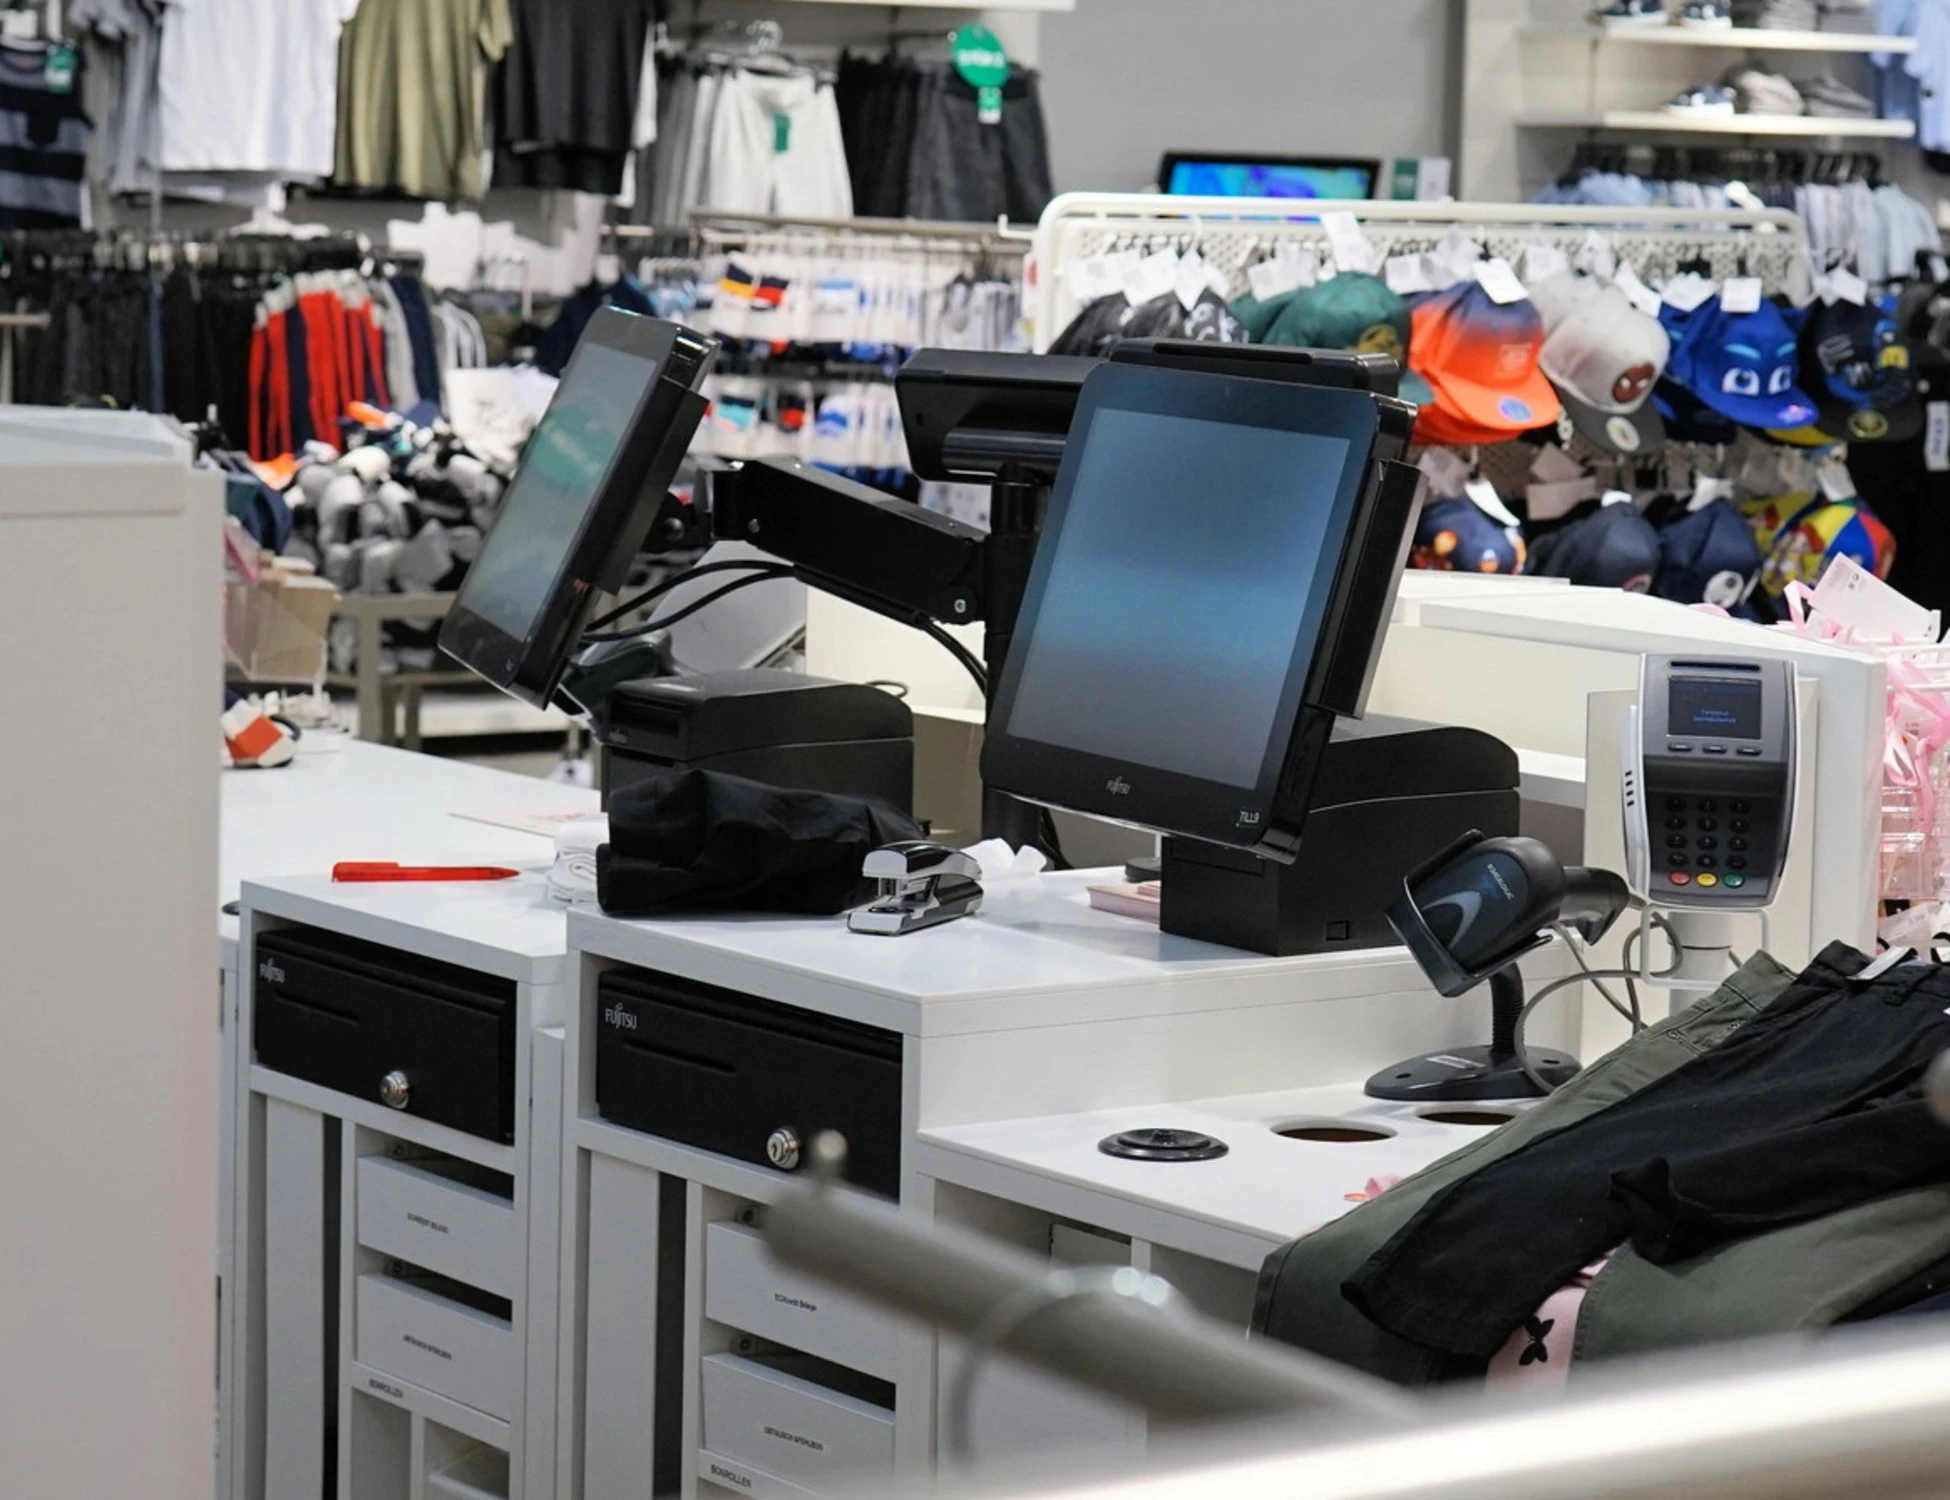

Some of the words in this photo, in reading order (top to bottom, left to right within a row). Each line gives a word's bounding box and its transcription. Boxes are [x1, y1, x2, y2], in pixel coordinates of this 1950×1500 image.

[1106, 775, 1131, 796] FUJITSU
[605, 1002, 637, 1030] FUJITSU
[710, 1463, 752, 1488] BONROLLEN
